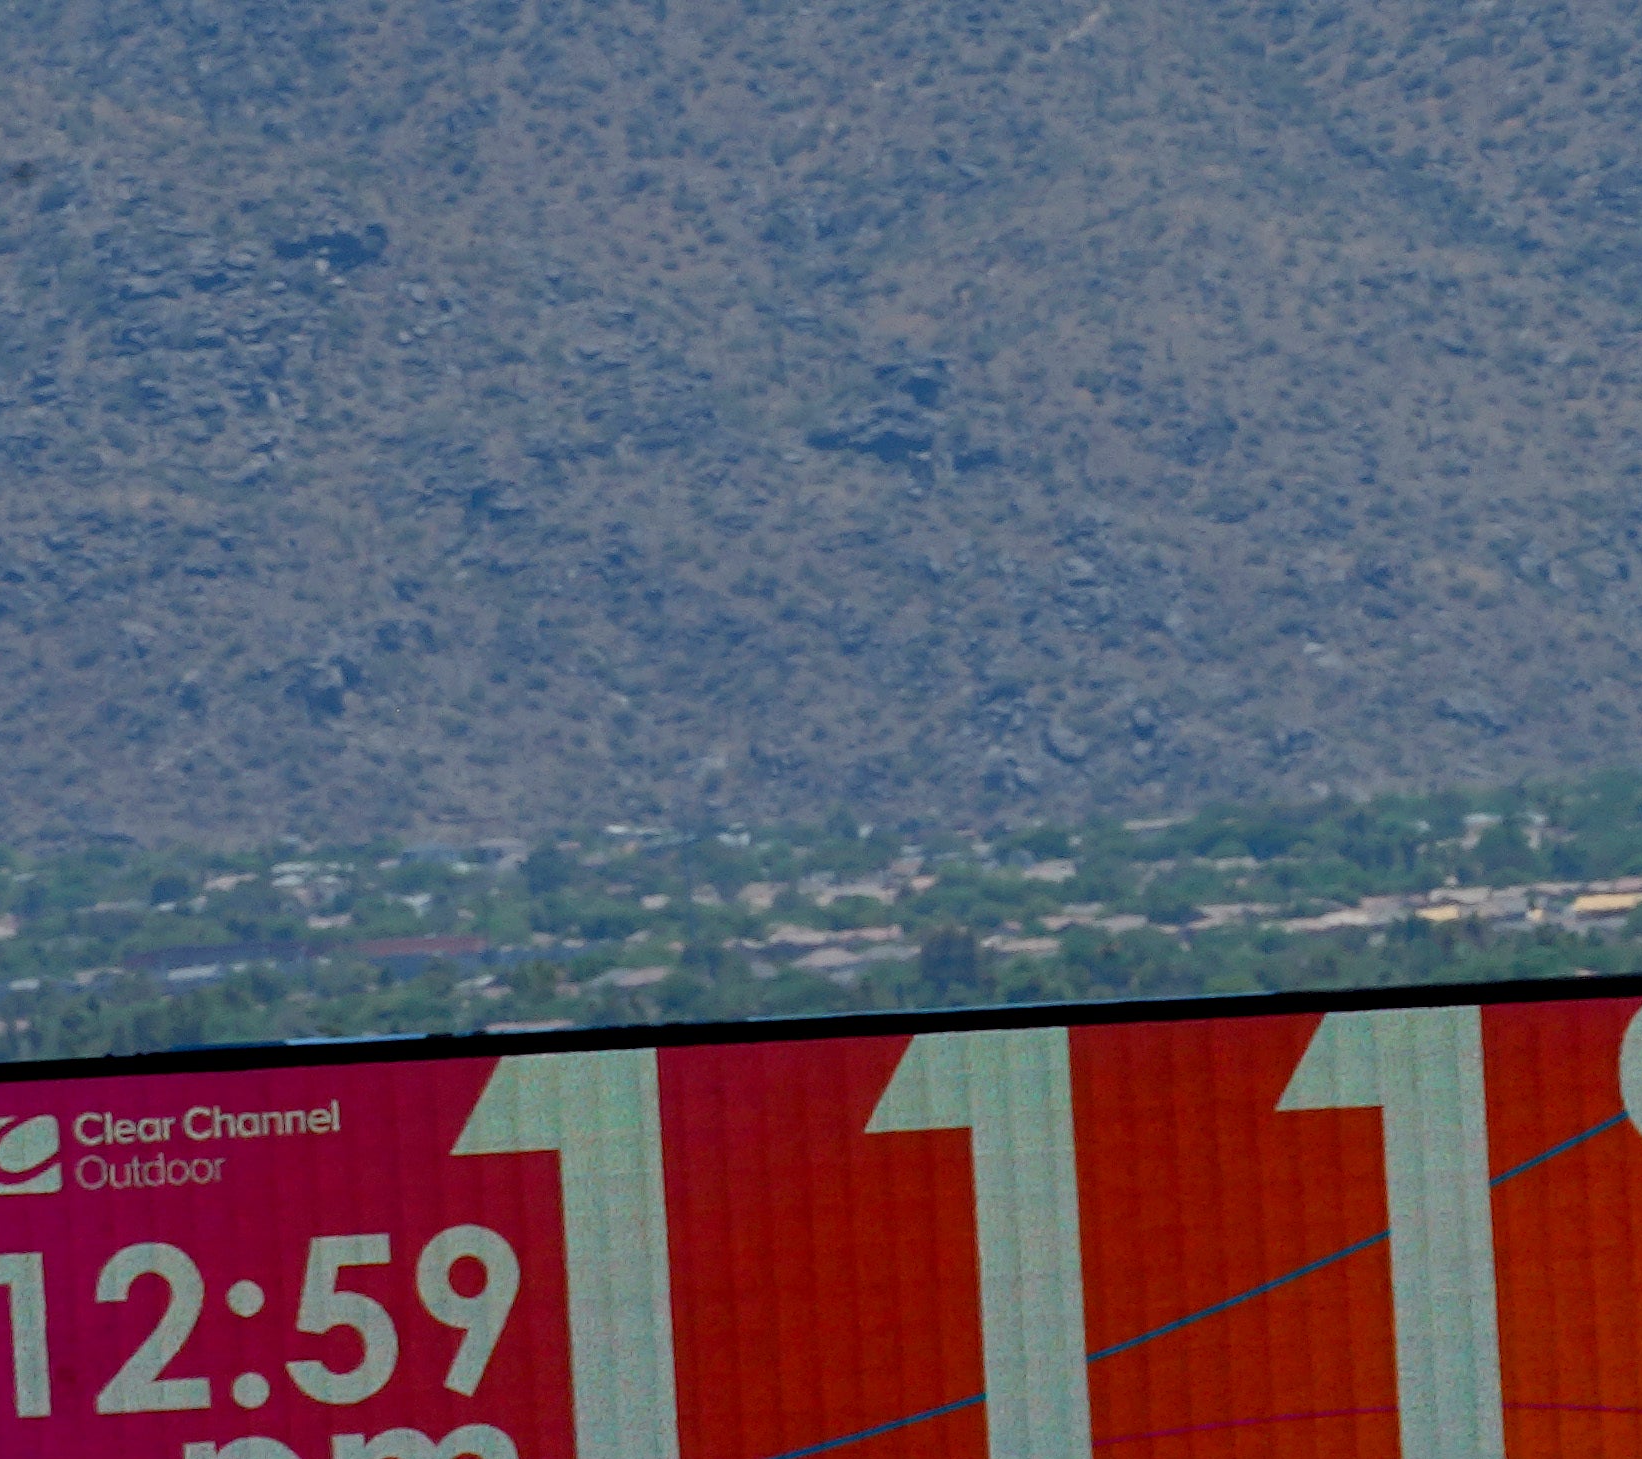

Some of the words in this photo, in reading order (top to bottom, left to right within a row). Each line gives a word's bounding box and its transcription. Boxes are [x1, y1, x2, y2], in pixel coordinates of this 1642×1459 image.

[73, 1111, 176, 1146] Clear
[182, 1099, 341, 1140] Channel
[75, 1152, 226, 1190] Outdoor
